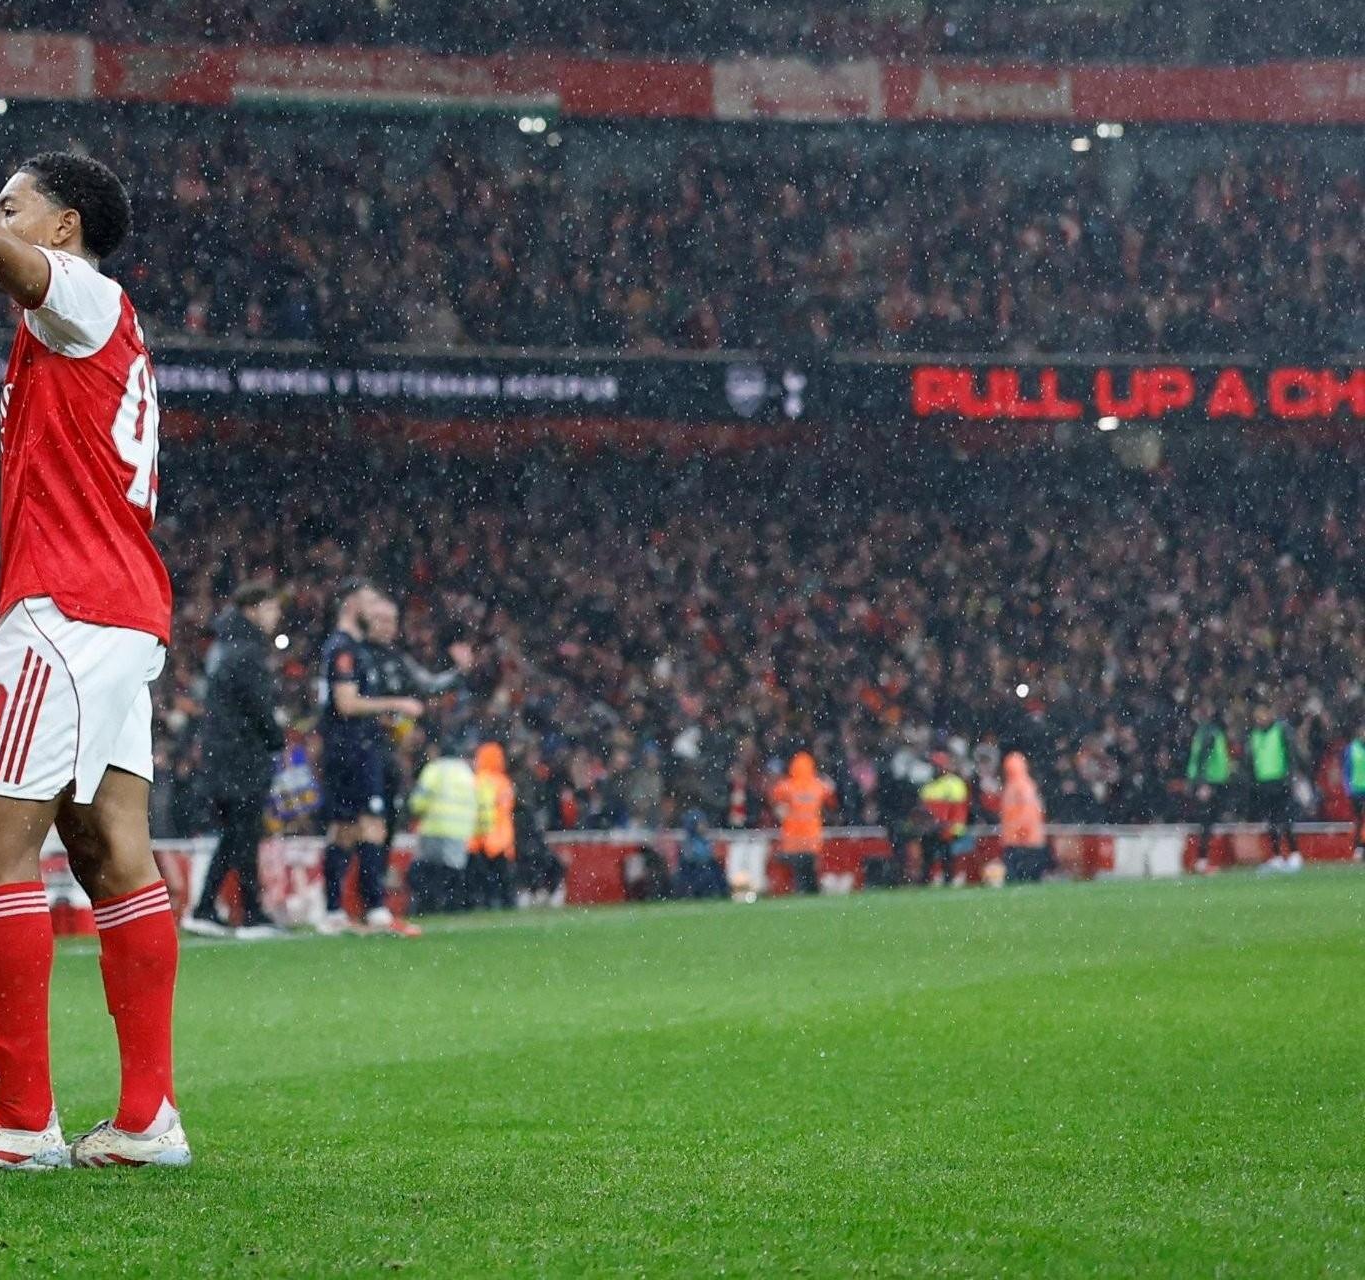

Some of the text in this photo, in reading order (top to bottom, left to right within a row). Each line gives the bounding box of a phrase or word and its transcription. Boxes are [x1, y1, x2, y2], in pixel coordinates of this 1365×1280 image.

[111, 353, 160, 520] 4
[912, 366, 1084, 419] PULL
[1094, 366, 1196, 419] UP
[1209, 366, 1258, 419] A
